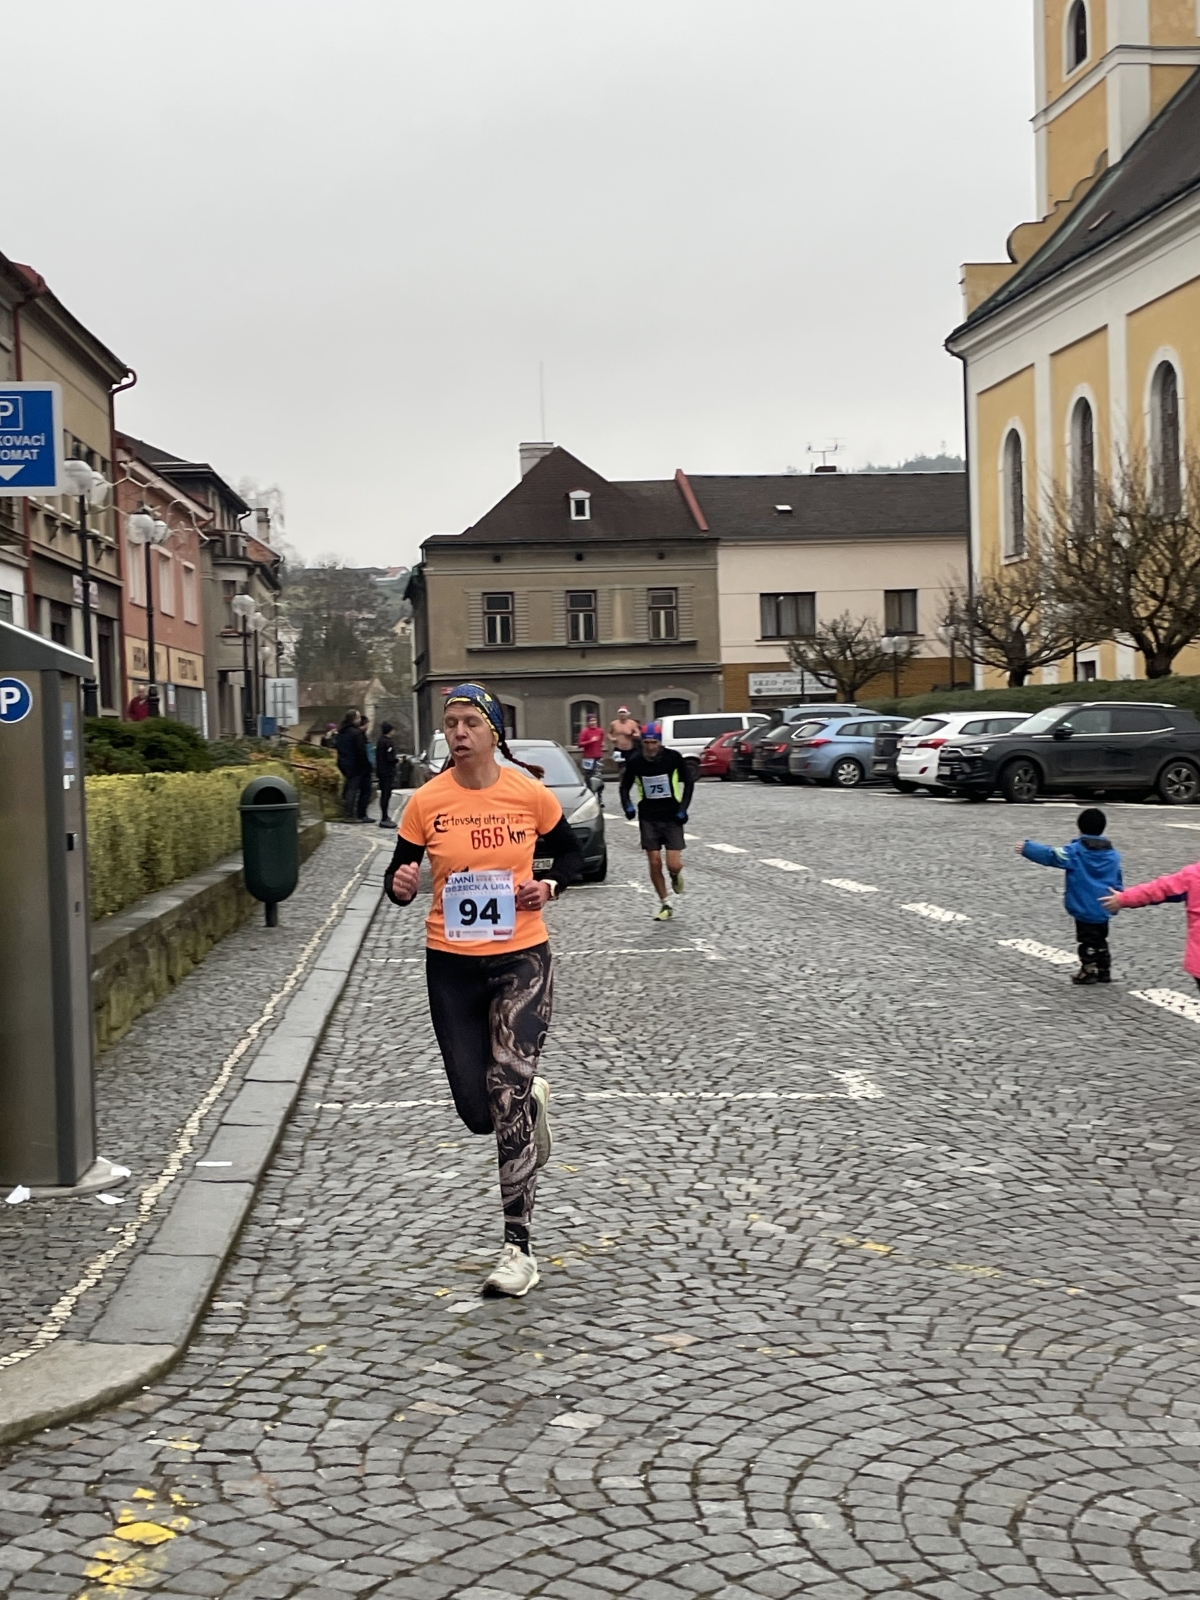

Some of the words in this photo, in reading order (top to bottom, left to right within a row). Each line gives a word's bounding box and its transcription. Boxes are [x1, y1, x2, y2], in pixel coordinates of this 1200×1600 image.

[0, 449, 40, 461] OMAT
[0, 687, 21, 714] P
[649, 784, 664, 794] 75
[506, 825, 527, 844] km
[459, 898, 501, 926] 94
